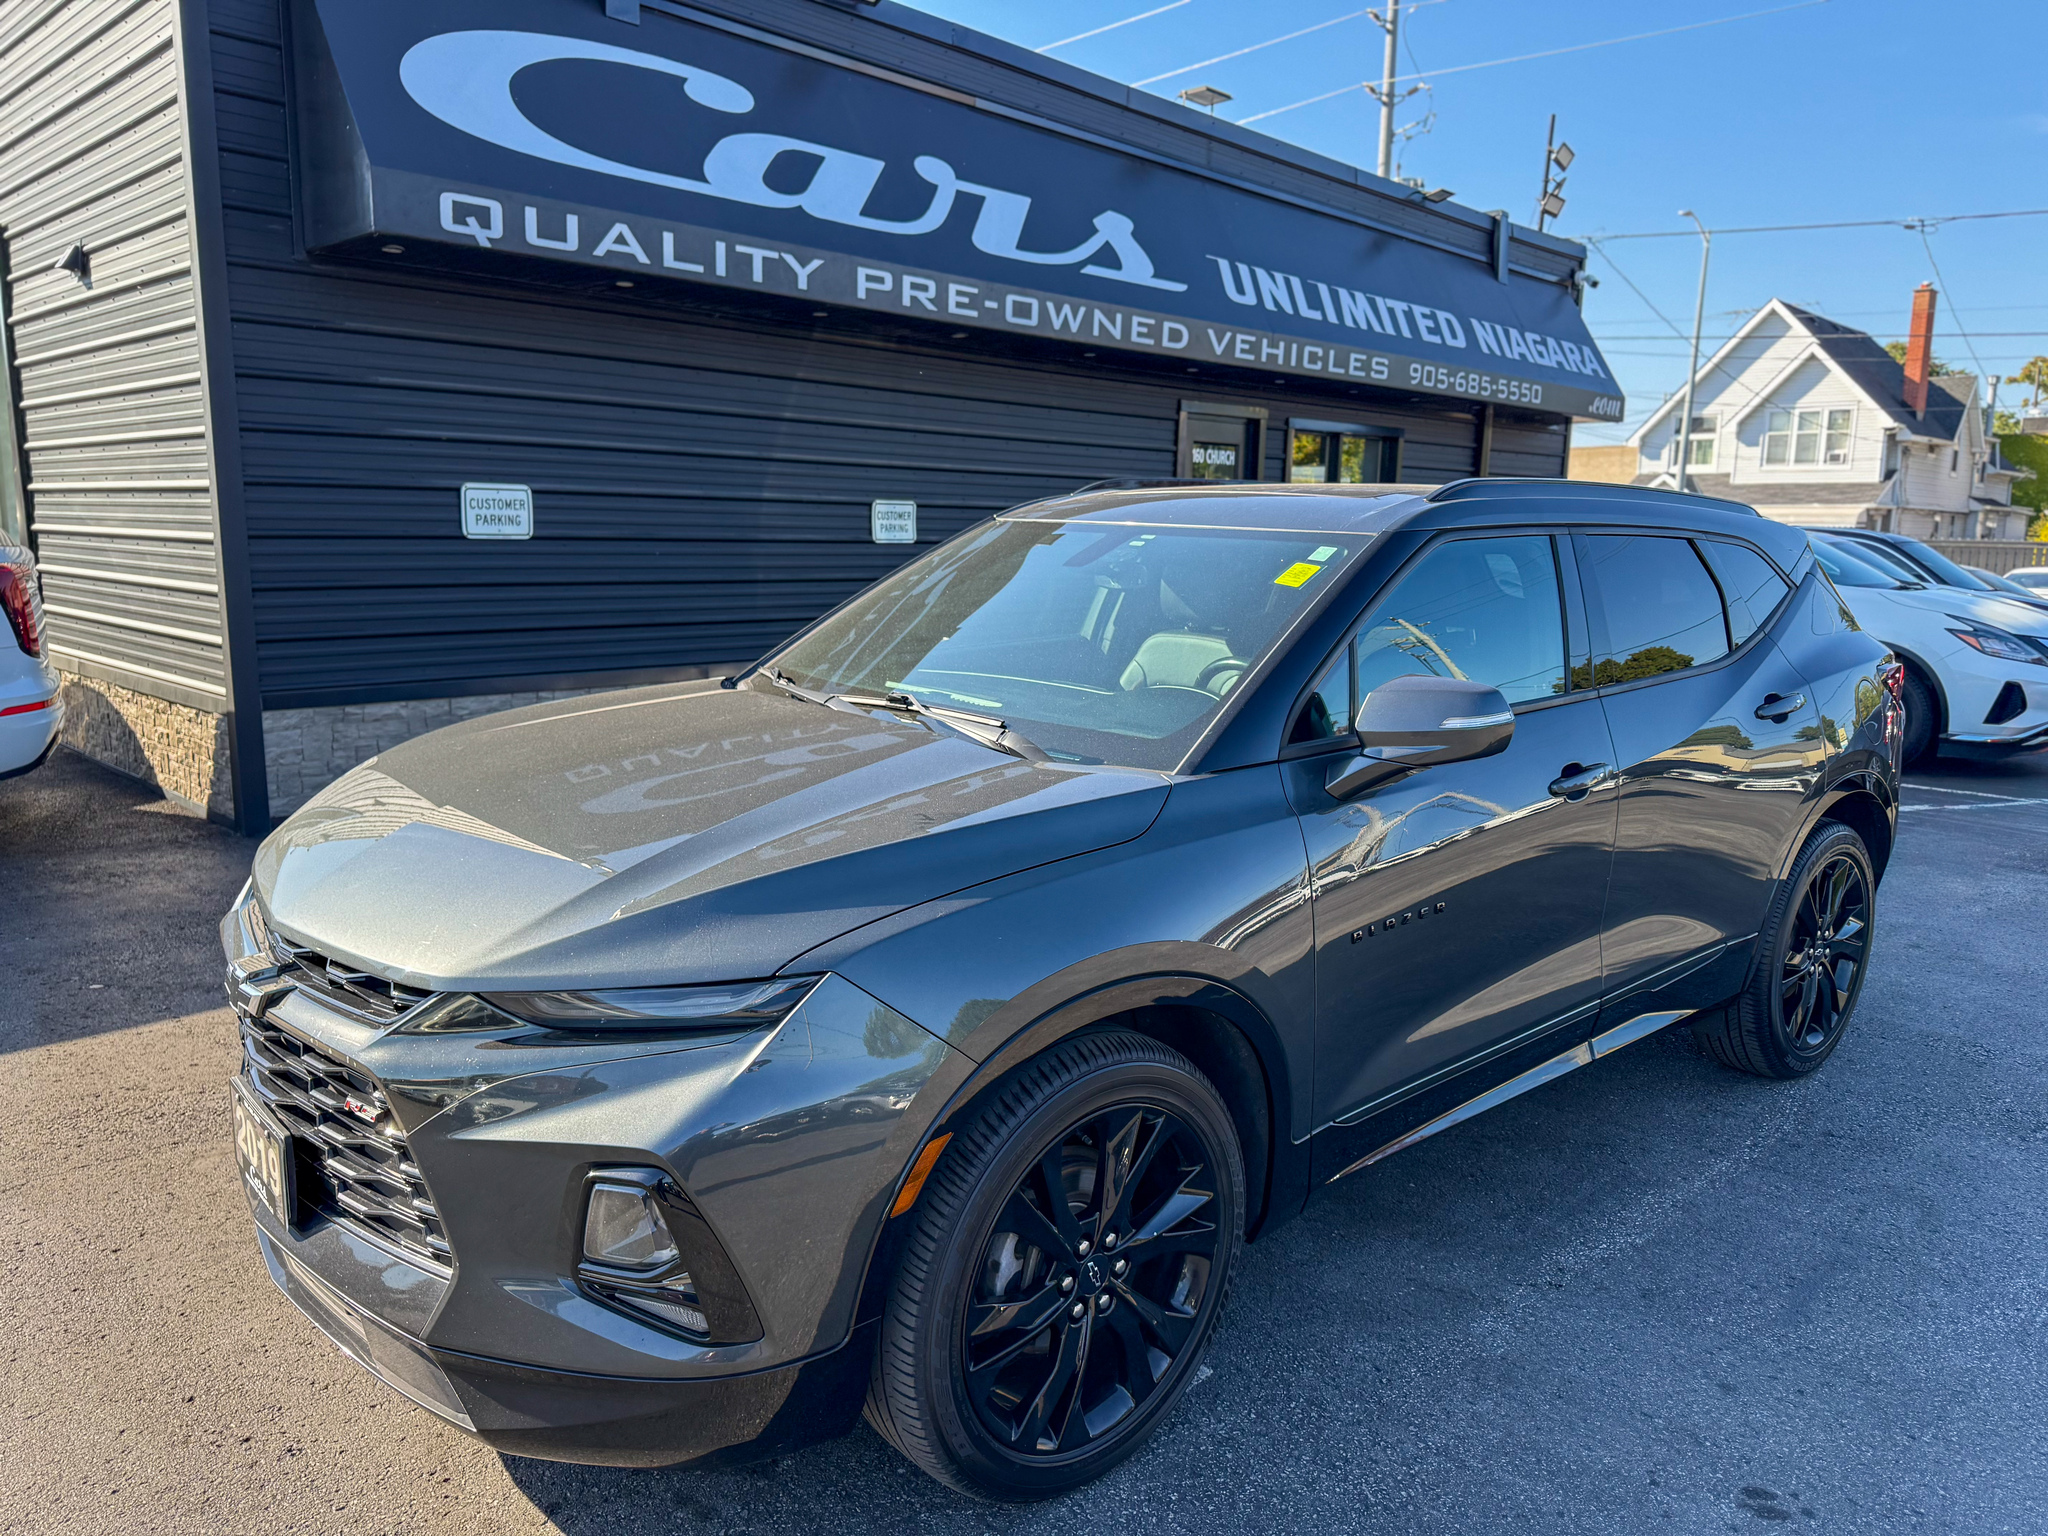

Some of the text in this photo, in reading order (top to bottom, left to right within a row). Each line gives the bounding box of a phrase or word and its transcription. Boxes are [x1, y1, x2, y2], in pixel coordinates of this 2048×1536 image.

[399, 28, 1608, 379] Cars UNLIMITED NIAGARA
[438, 191, 1389, 380] QUALITY PRE-OWNED VEHICLES
[1205, 448, 1236, 466] CHURCH
[469, 497, 526, 511] CUSTOMER
[475, 513, 522, 527] PARKING
[876, 510, 912, 521] CUSTOMER
[880, 523, 909, 533] PARKING
[1351, 901, 1446, 944] BLAZER
[235, 1104, 281, 1198] 2019
